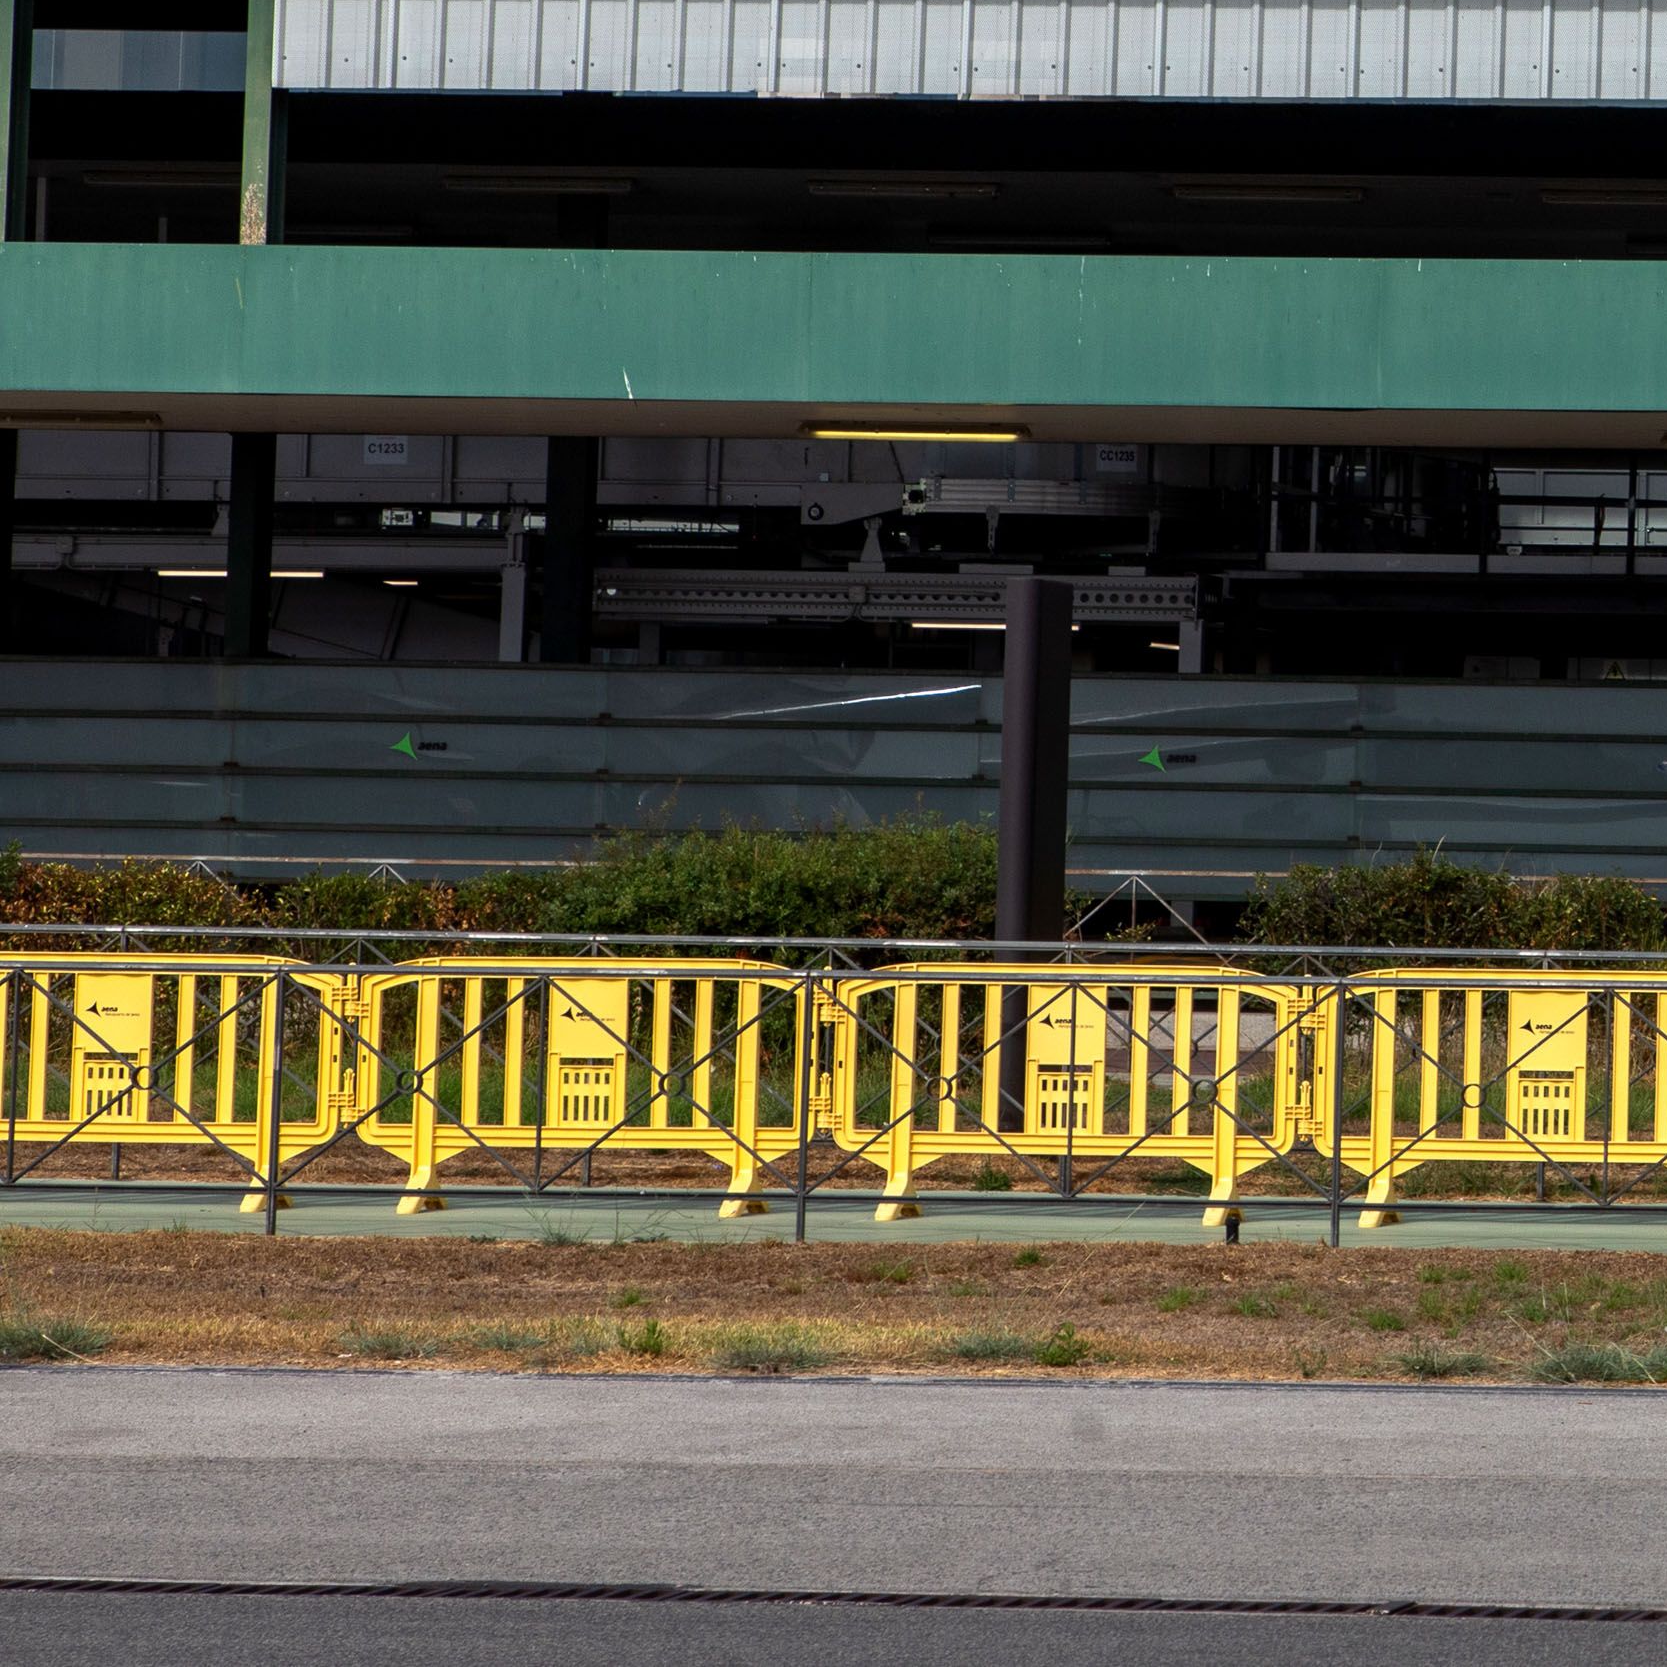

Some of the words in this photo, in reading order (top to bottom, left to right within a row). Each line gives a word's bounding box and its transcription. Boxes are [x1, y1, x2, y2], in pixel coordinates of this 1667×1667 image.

[368, 443, 404, 454] C1233
[418, 742, 447, 751] aena
[1166, 754, 1196, 763] aena
